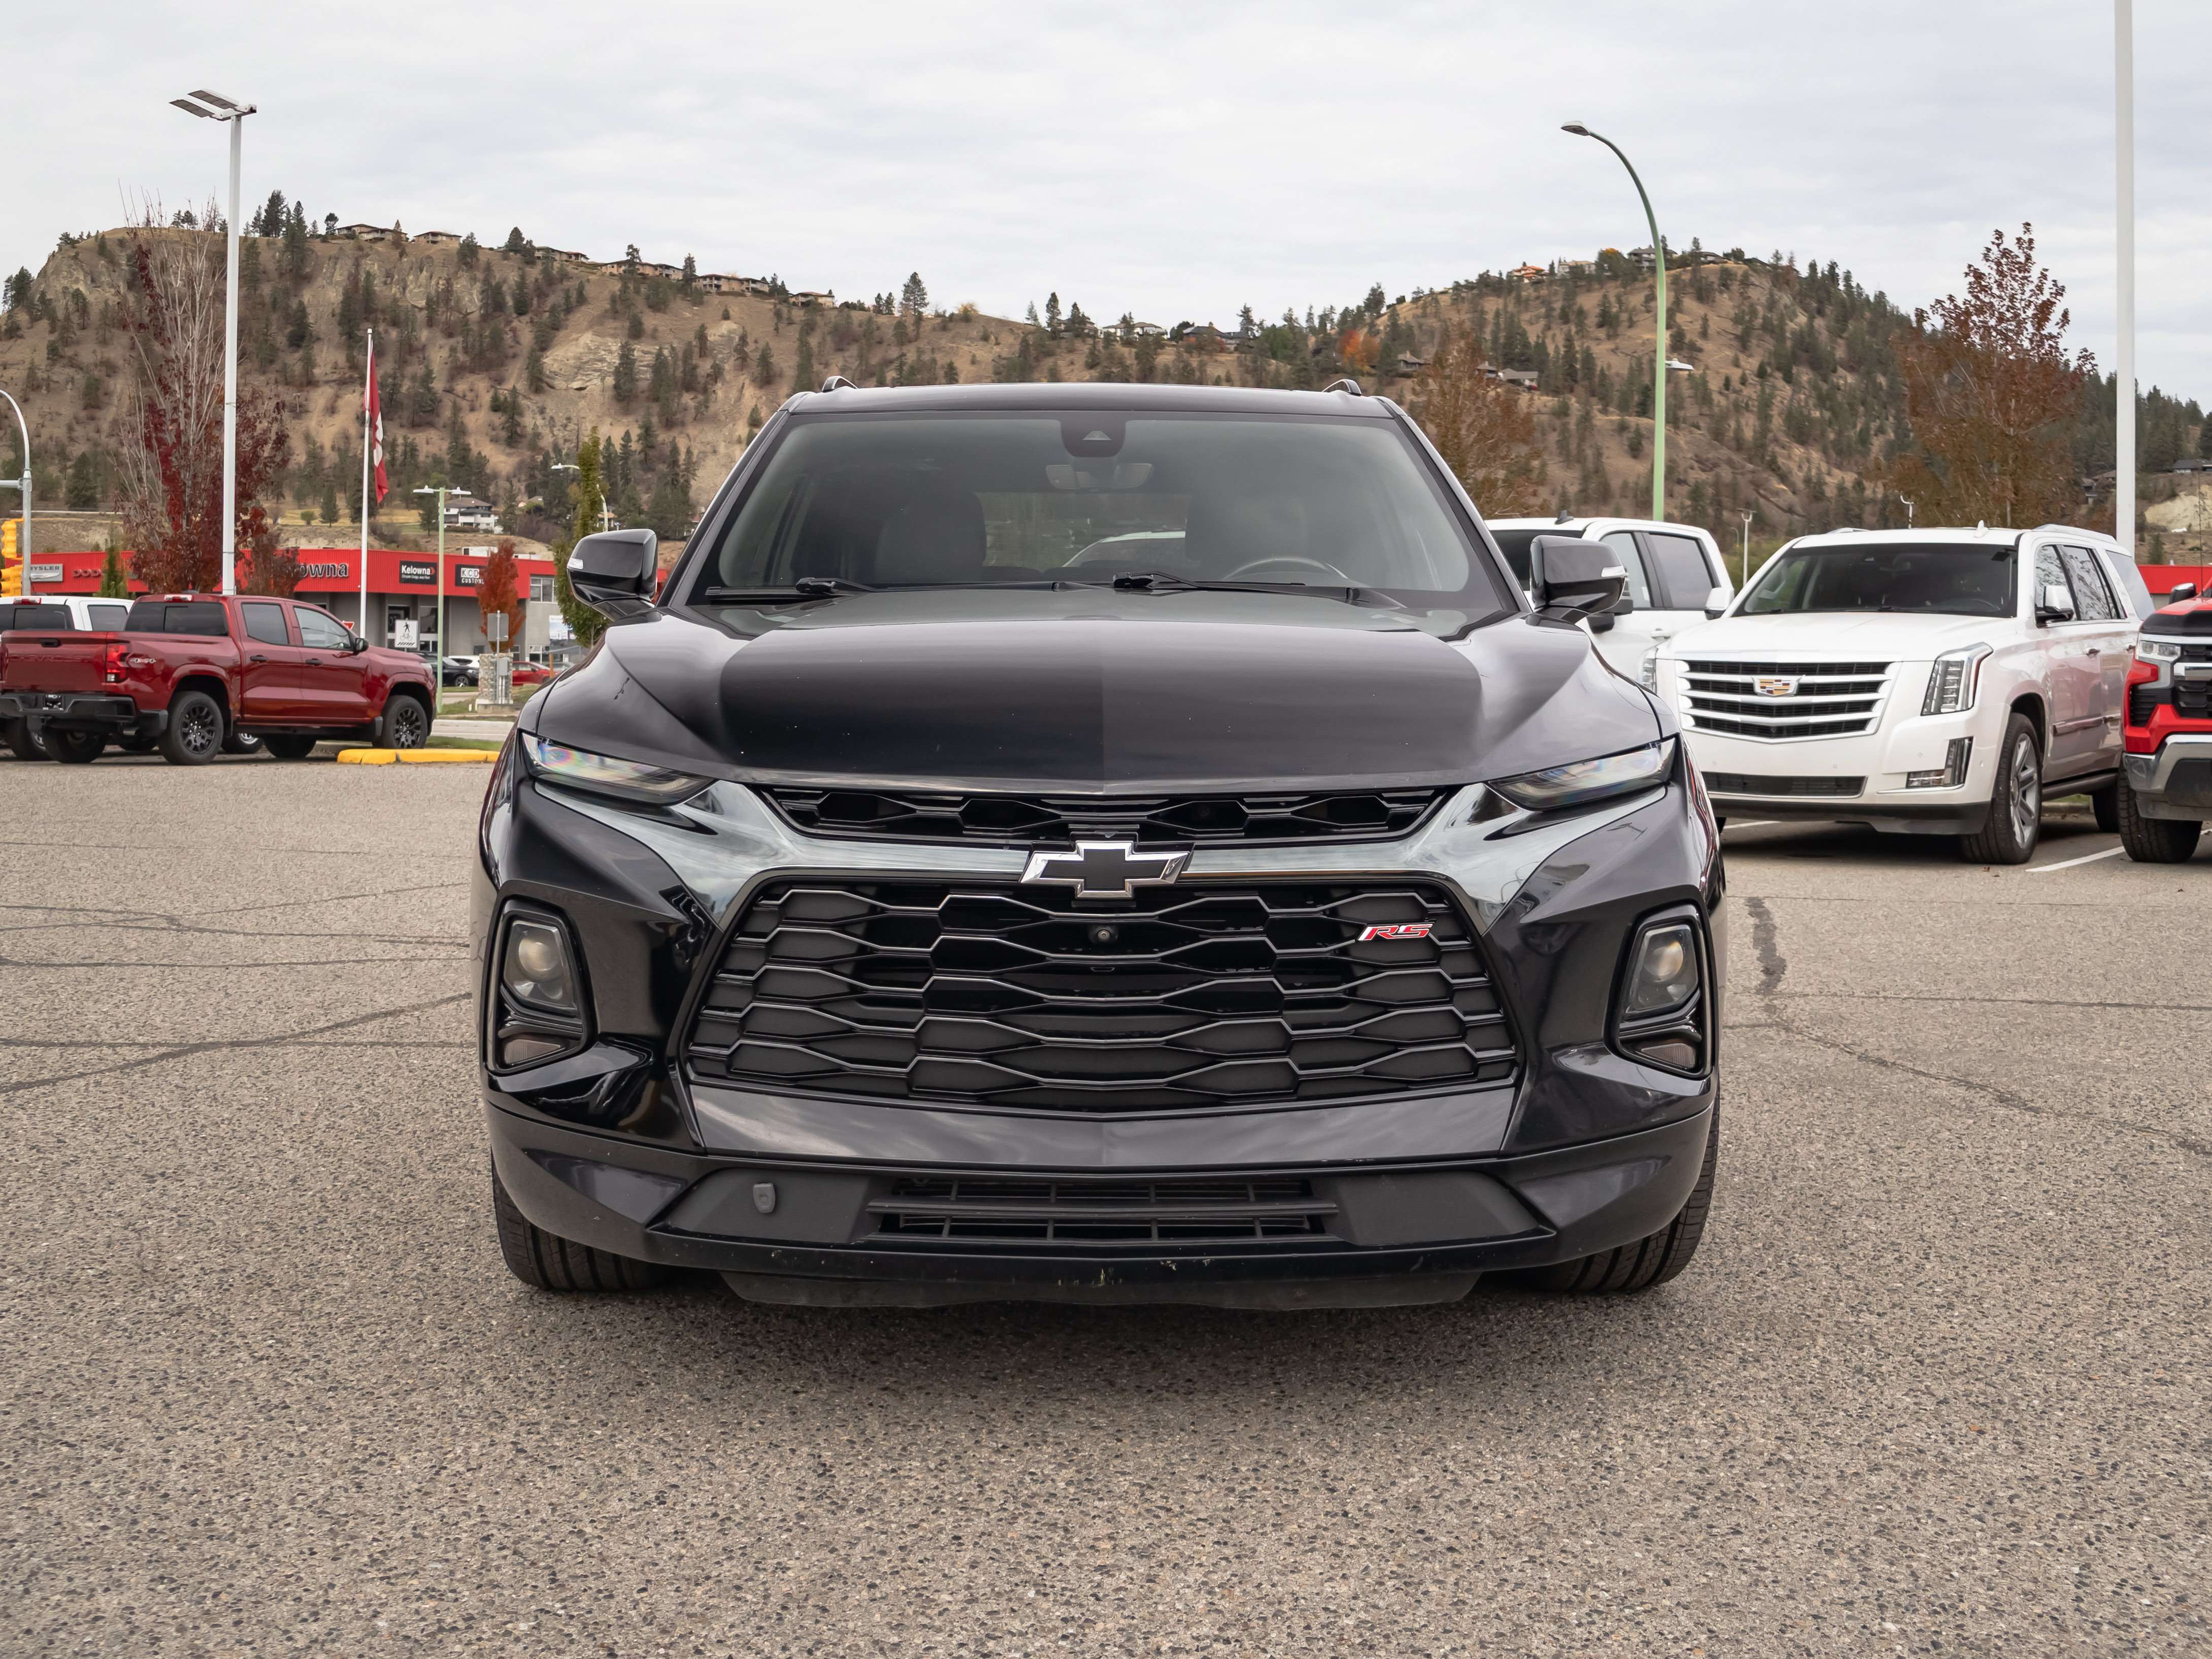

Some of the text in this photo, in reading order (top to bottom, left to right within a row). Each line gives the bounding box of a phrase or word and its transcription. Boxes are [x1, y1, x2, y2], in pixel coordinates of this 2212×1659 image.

[73, 569, 102, 577] DOD
[300, 563, 349, 577] owna
[402, 565, 431, 575] Kelowna
[462, 569, 479, 577] KCD
[1358, 923, 1433, 941] RS
